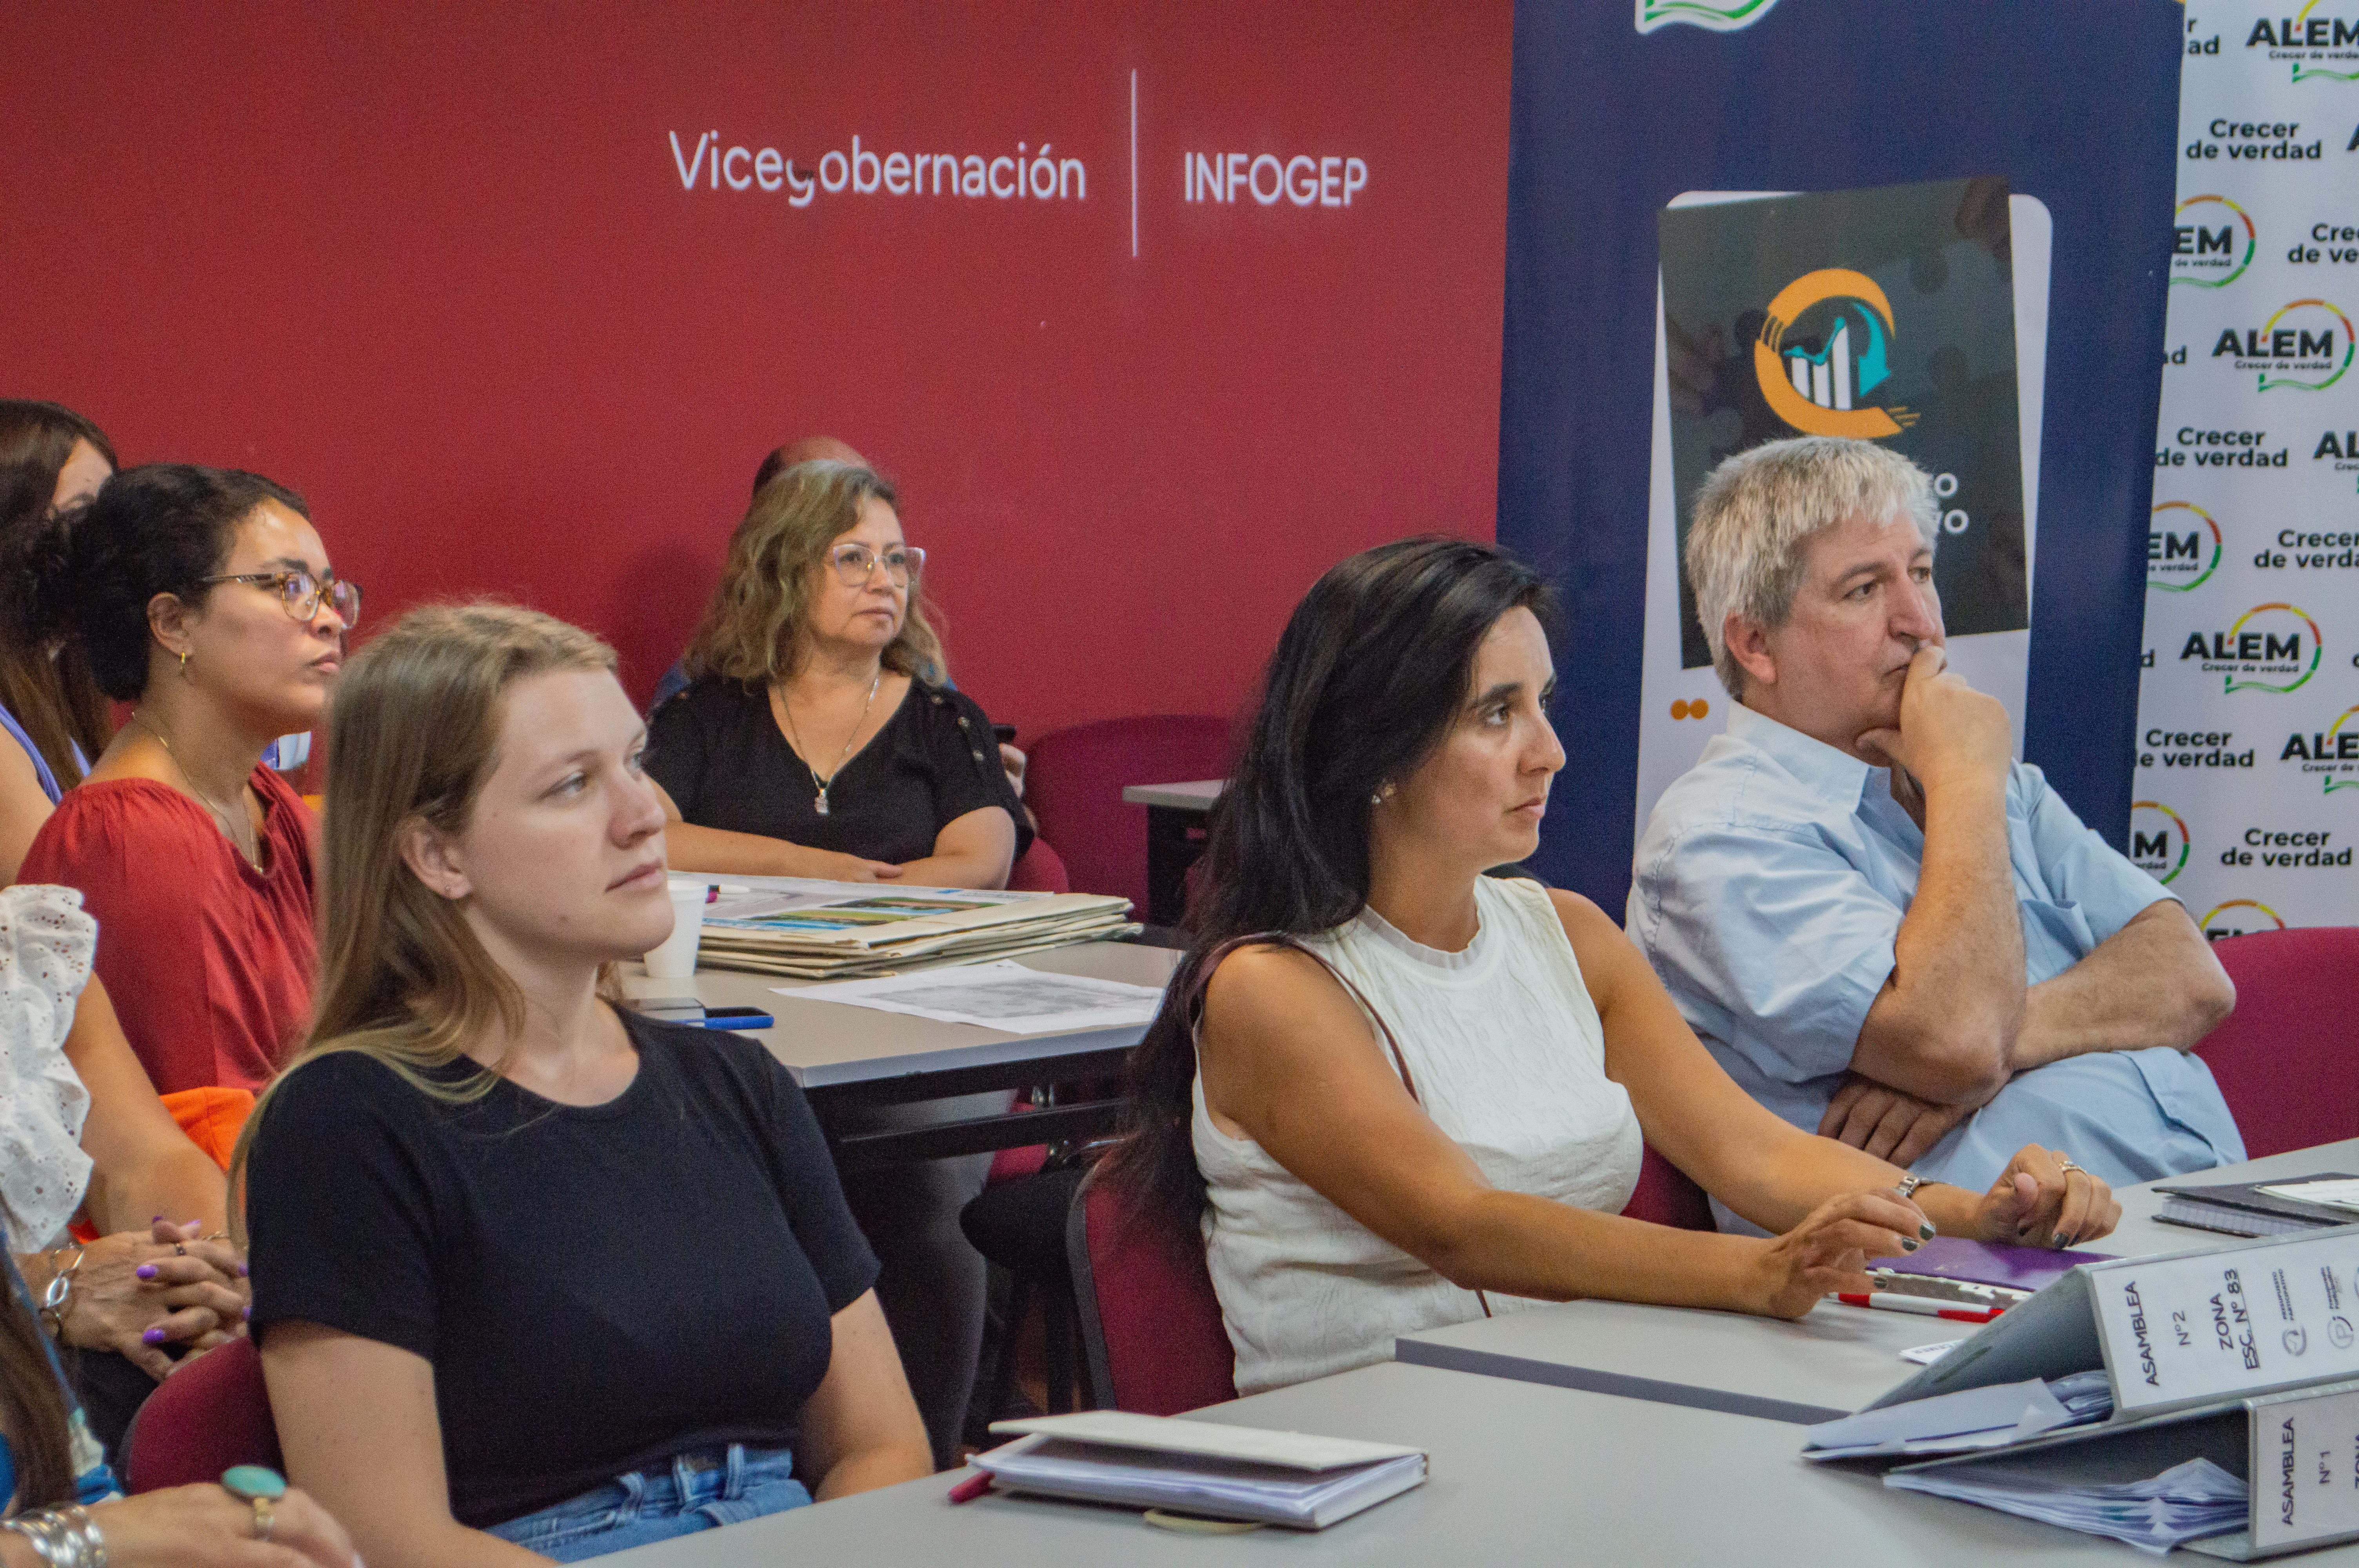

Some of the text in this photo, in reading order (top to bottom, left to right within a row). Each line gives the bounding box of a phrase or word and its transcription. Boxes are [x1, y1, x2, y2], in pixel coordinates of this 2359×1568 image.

[2246, 18, 2359, 47] ALEM
[2269, 50, 2359, 59] Crecer de verda
[2210, 119, 2299, 138] Crecer
[2186, 140, 2322, 159] de verdad
[1184, 152, 1368, 206] INFOGEP
[2174, 226, 2232, 254] EM
[2312, 223, 2359, 242] Cre
[2288, 244, 2320, 263] de
[2212, 328, 2333, 358] ALEM
[2236, 360, 2332, 370] Crecer de verdad
[2177, 427, 2265, 446] Crecer
[2314, 431, 2359, 459] AL
[2156, 448, 2288, 467] de verdad
[2149, 532, 2200, 559] EM
[2254, 550, 2359, 568] de verd
[2180, 632, 2300, 661] ALEM
[2202, 663, 2299, 673] Crecer de verdad
[2146, 730, 2232, 747] Crecer
[2280, 733, 2359, 760] ALE
[2140, 749, 2254, 767] e verdad
[2245, 828, 2330, 846] Crecer
[2221, 847, 2352, 866] de verdad
[2225, 1269, 2240, 1294] 83
[2210, 1293, 2234, 1350] ZONA
[2125, 1281, 2160, 1387] ASAMBLEA
[2282, 1417, 2294, 1526] ASAMBLEA
